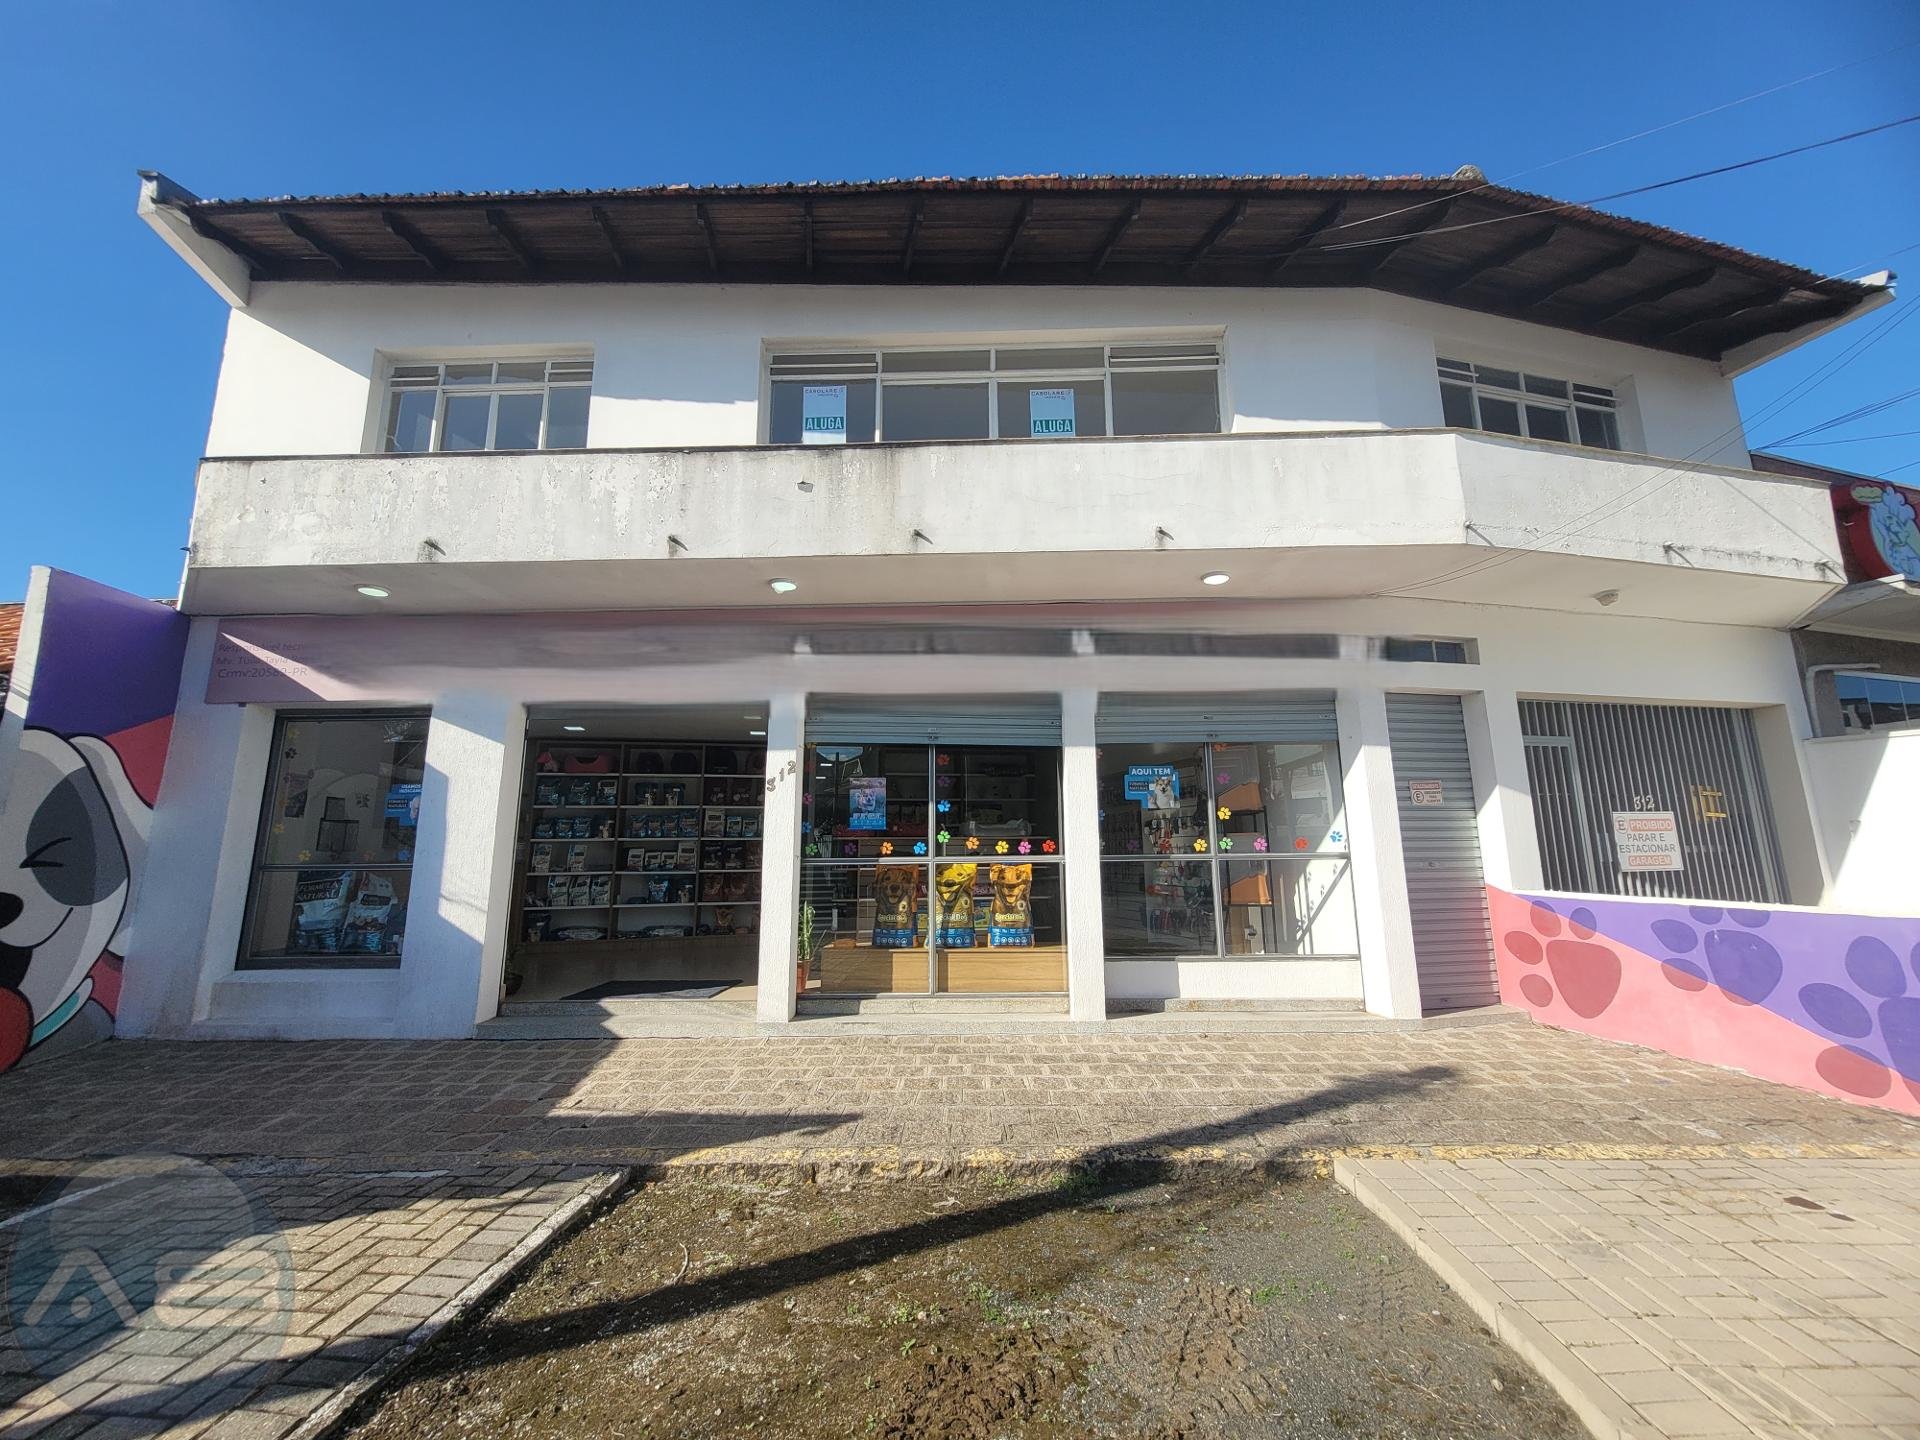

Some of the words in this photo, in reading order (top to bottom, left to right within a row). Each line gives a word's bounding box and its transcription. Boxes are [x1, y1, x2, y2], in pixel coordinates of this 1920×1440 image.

[806, 417, 842, 429] ALUGA
[1035, 420, 1071, 432] ALUGA
[766, 759, 797, 792] 312
[1131, 768, 1152, 776] AQUI
[1634, 795, 1655, 809] 312
[1629, 820, 1672, 831] PROIBIDO
[1627, 832, 1658, 842] PARAR
[1659, 832, 1666, 842] E
[1619, 844, 1676, 853] ESTACIONAR
[1629, 855, 1672, 866] GARAGEM
